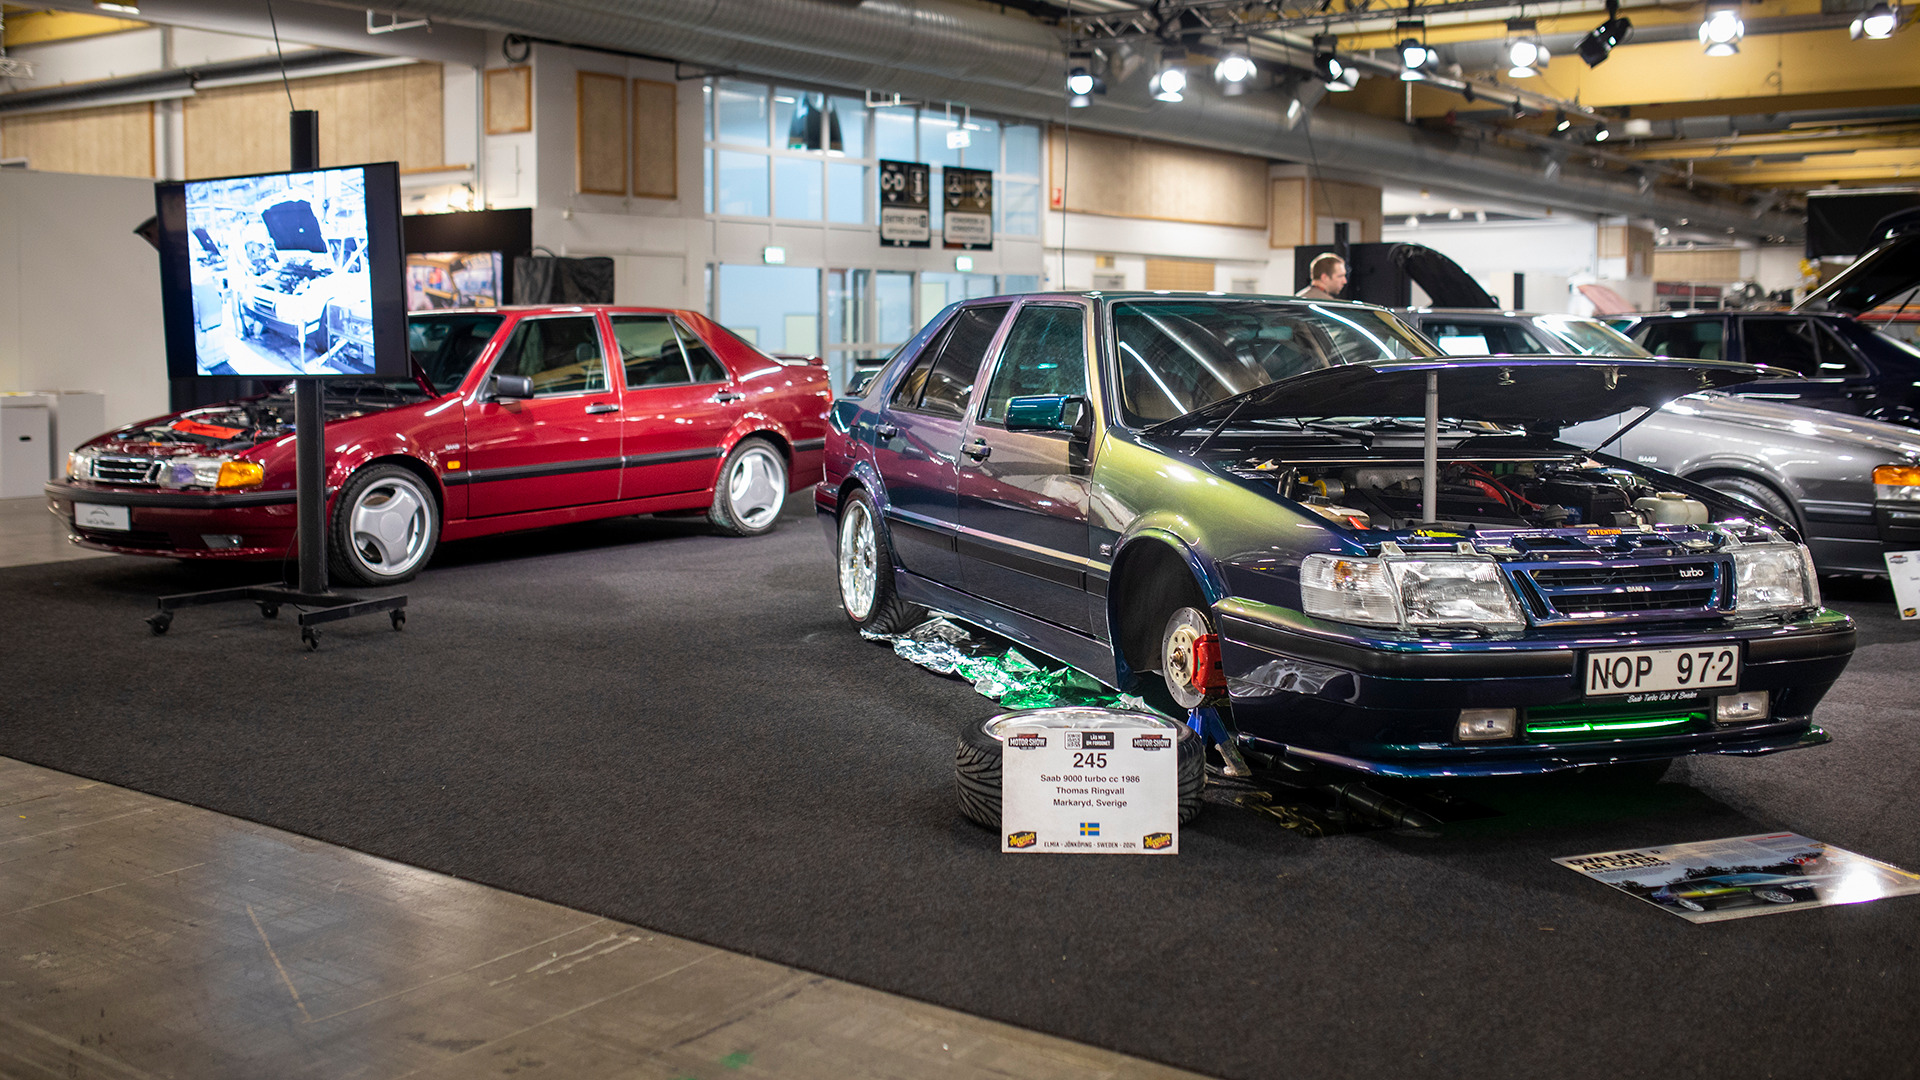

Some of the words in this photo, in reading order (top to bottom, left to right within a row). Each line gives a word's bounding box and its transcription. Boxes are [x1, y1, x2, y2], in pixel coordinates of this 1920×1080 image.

[1638, 455, 1657, 463] SAAB
[1680, 567, 1704, 577] turbo
[1591, 656, 1653, 690] NOP
[1677, 650, 1734, 685] 972
[1627, 694, 1643, 703] Saab
[1643, 693, 1658, 702] Turbo
[1659, 691, 1671, 701] Club
[1671, 691, 1679, 700] of
[1678, 691, 1698, 700] Sweden
[1010, 738, 1028, 746] MOTOR
[1029, 738, 1045, 746] SHOW
[1134, 739, 1152, 747] MOTOR
[1153, 739, 1170, 747] SHOW
[1073, 752, 1107, 768] 245
[1040, 774, 1061, 782] Saab
[1063, 775, 1083, 783] 9000
[1084, 775, 1106, 783] turbo
[1121, 775, 1140, 783] 1986
[1056, 786, 1089, 795] Thomas
[1091, 787, 1125, 796] Ringvall
[1053, 798, 1094, 808] Markaryd,
[1096, 799, 1128, 808] Sverige
[1064, 840, 1092, 848] JÖNKÖPING
[1122, 841, 1136, 849] 2024
